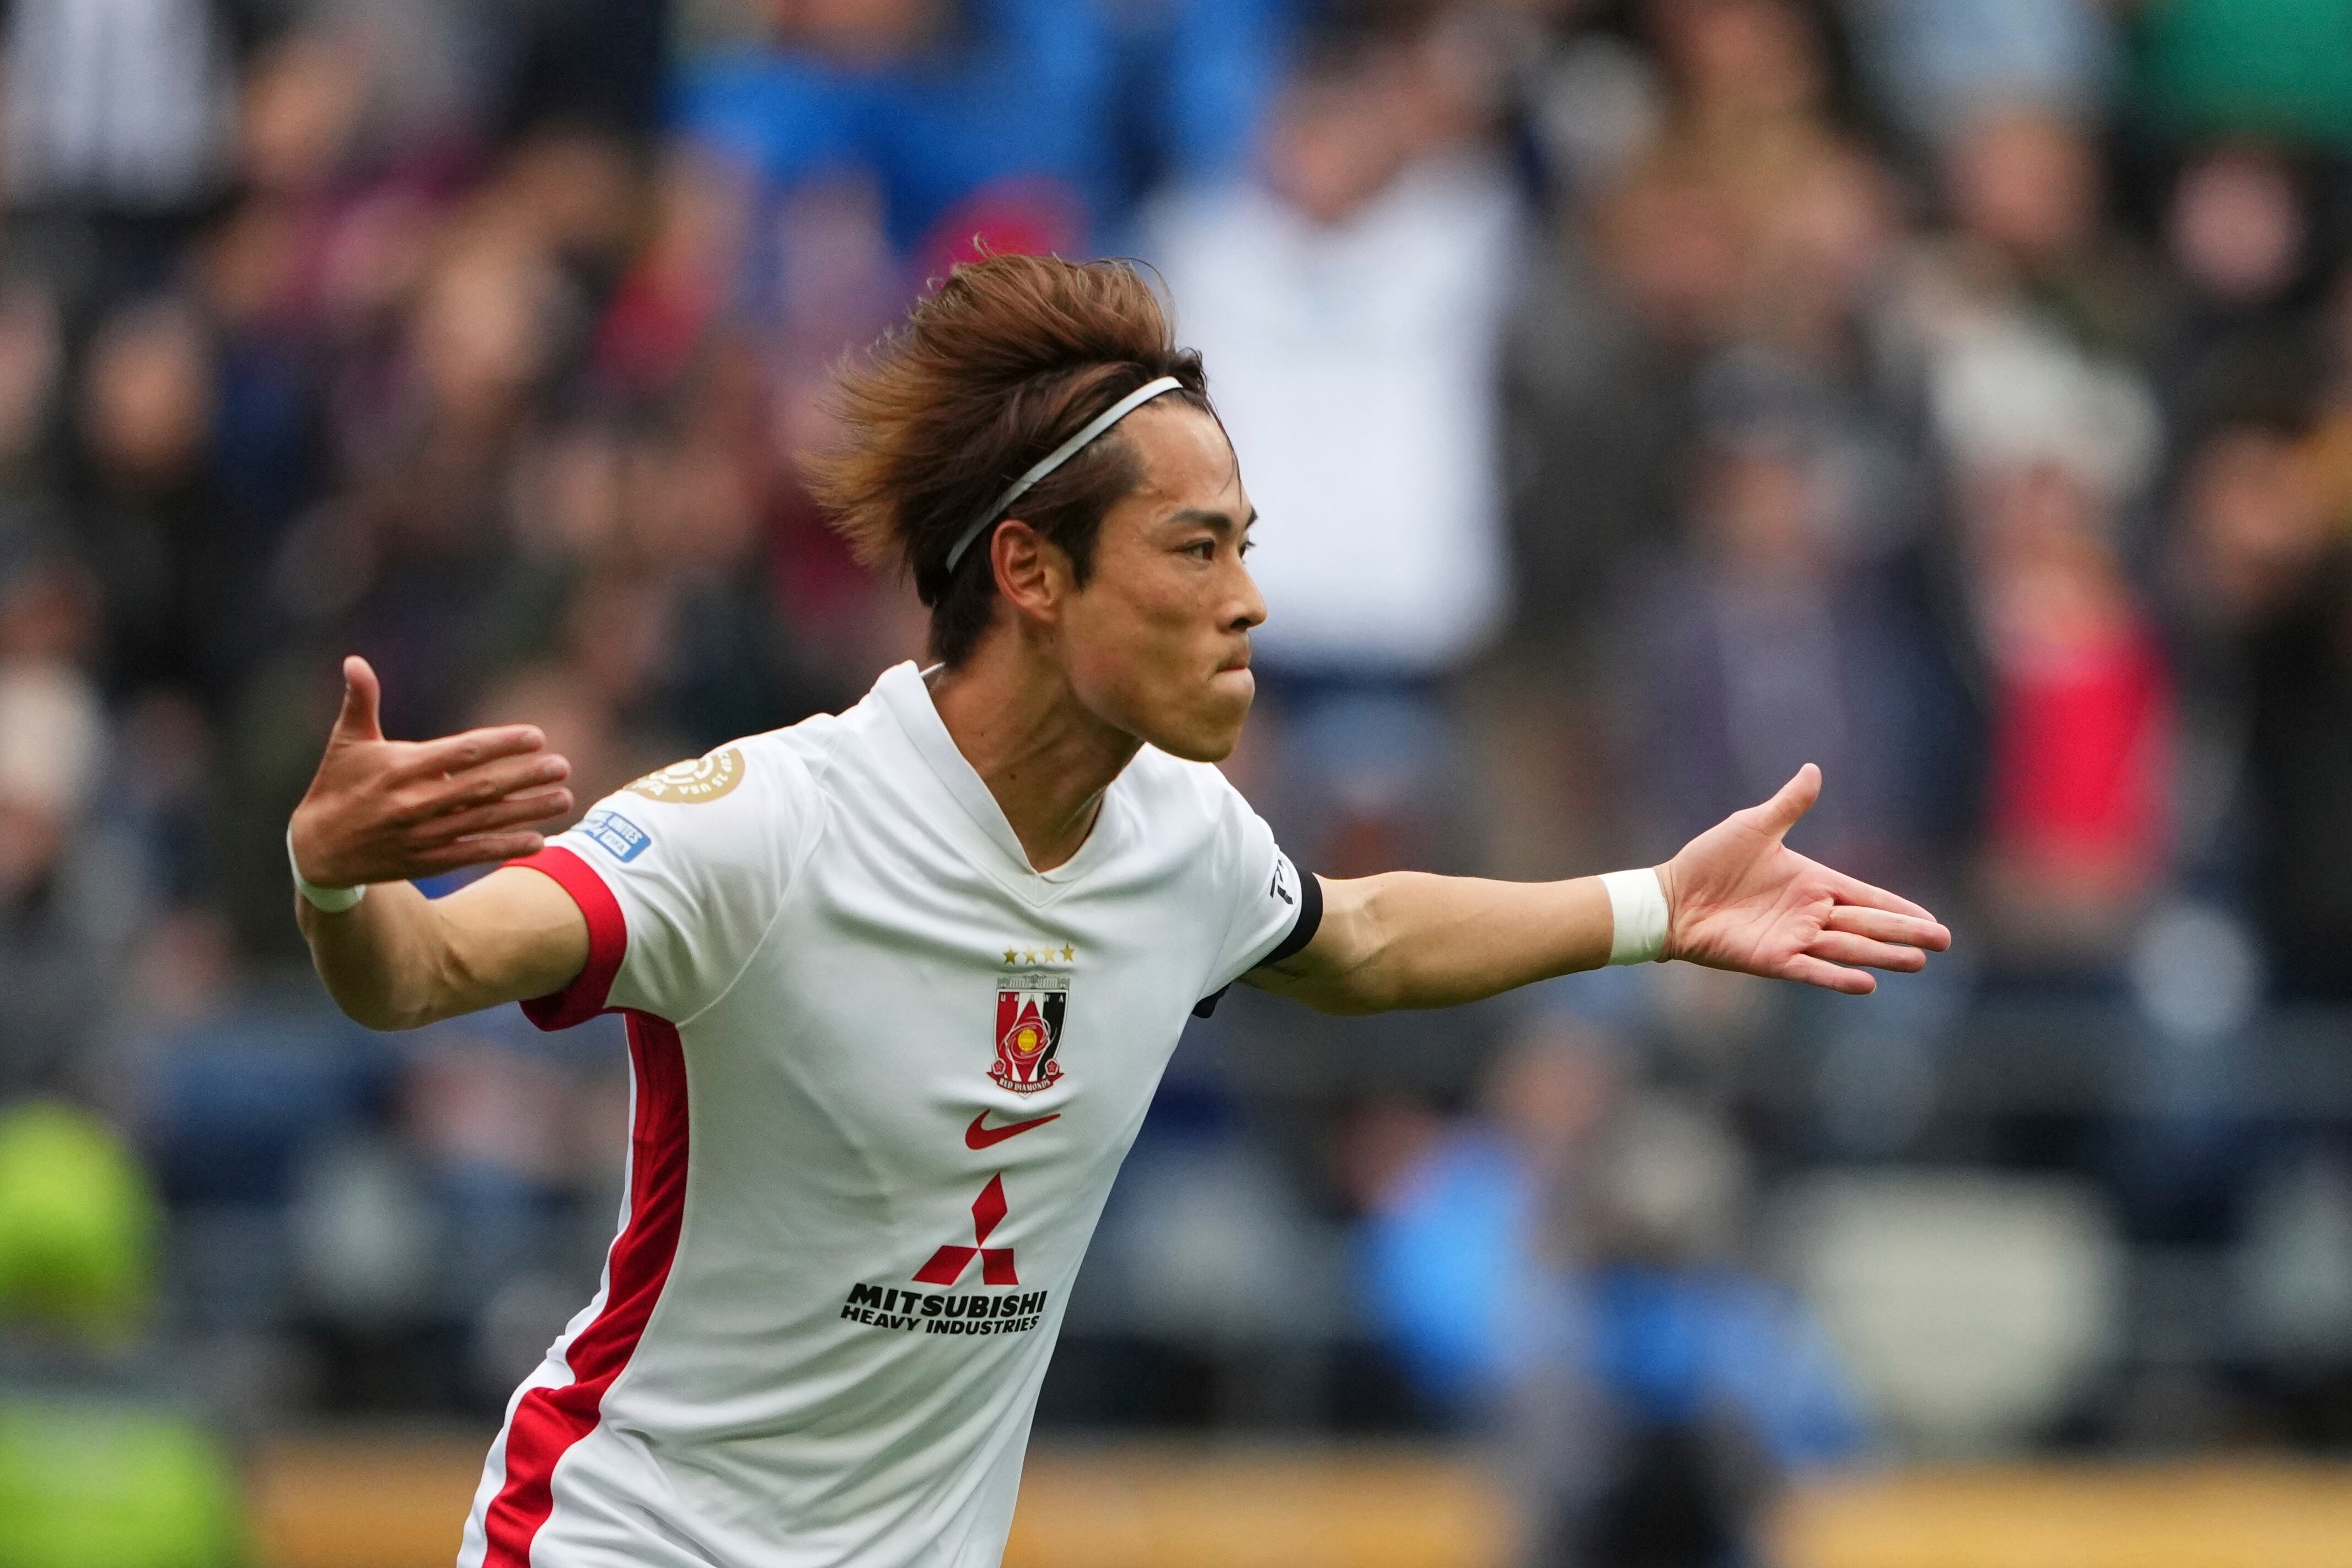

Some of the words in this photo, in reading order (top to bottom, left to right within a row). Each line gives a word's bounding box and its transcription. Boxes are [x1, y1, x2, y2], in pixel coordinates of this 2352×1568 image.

[711, 772, 729, 788] 25
[678, 784, 712, 794] USA
[999, 1078, 1013, 1088] RED
[1014, 1079, 1051, 1091] DIAMONDS
[846, 1283, 1048, 1318] MITSUBISHI
[840, 1305, 921, 1331] HEAVY
[926, 1315, 1040, 1335] INDUSTRIES
